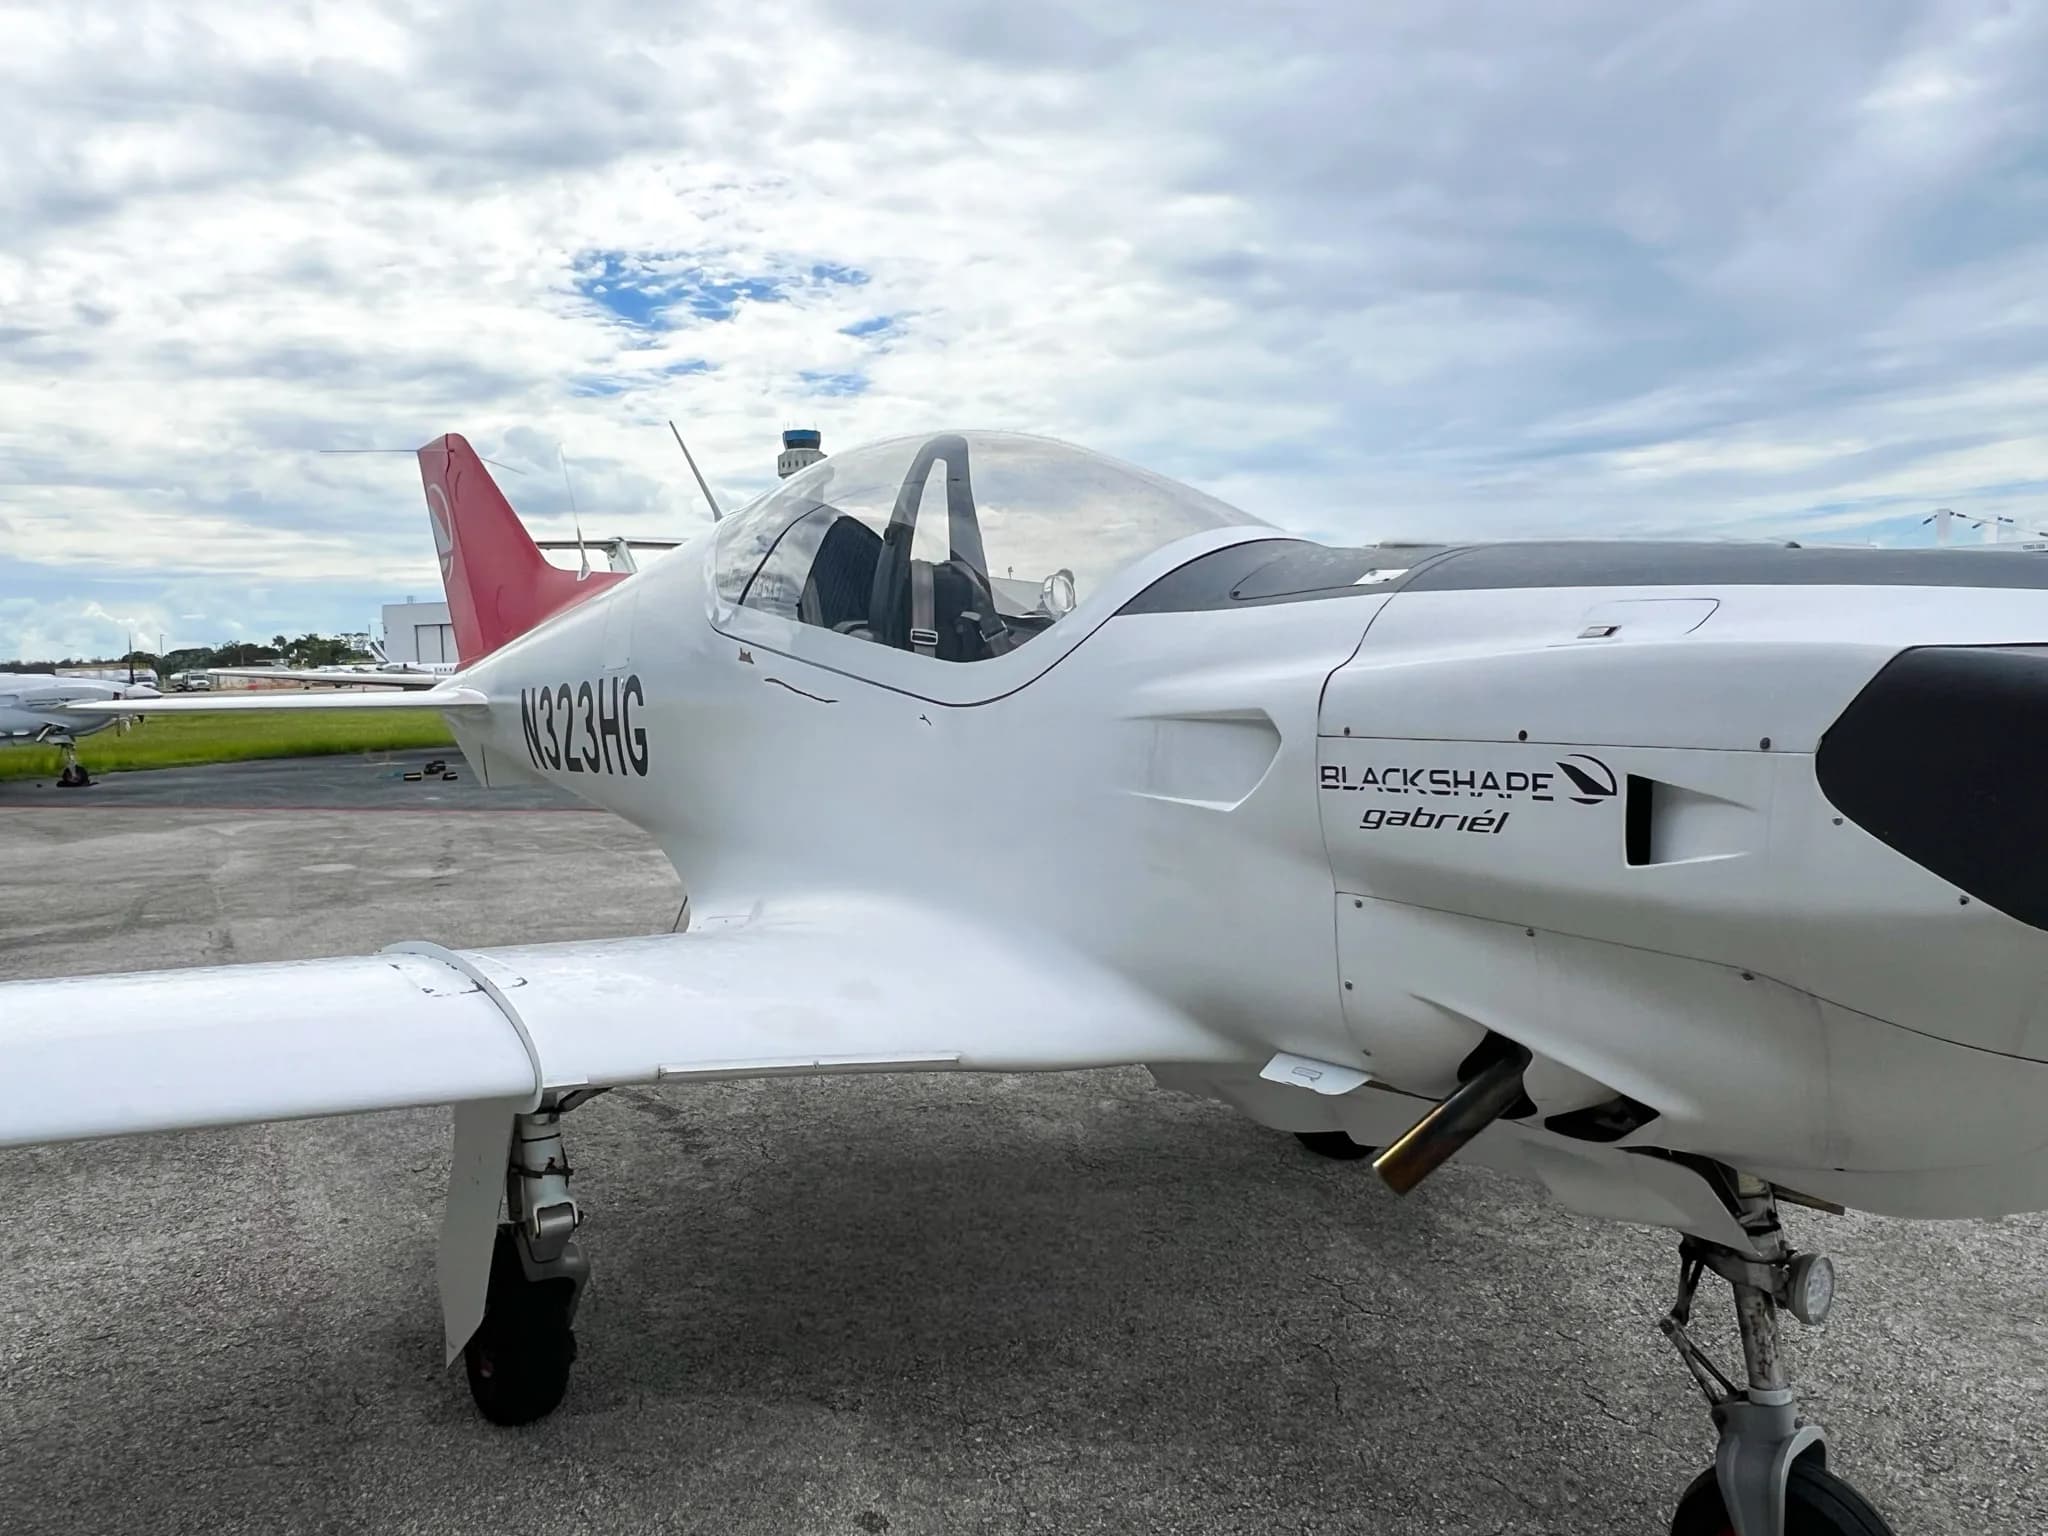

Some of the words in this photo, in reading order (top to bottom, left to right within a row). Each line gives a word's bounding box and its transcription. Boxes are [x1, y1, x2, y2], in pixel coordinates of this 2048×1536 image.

[521, 674, 649, 777] N323HG
[1320, 765, 1554, 801] BLACKSHAPE
[1359, 807, 1511, 834] gabriél
